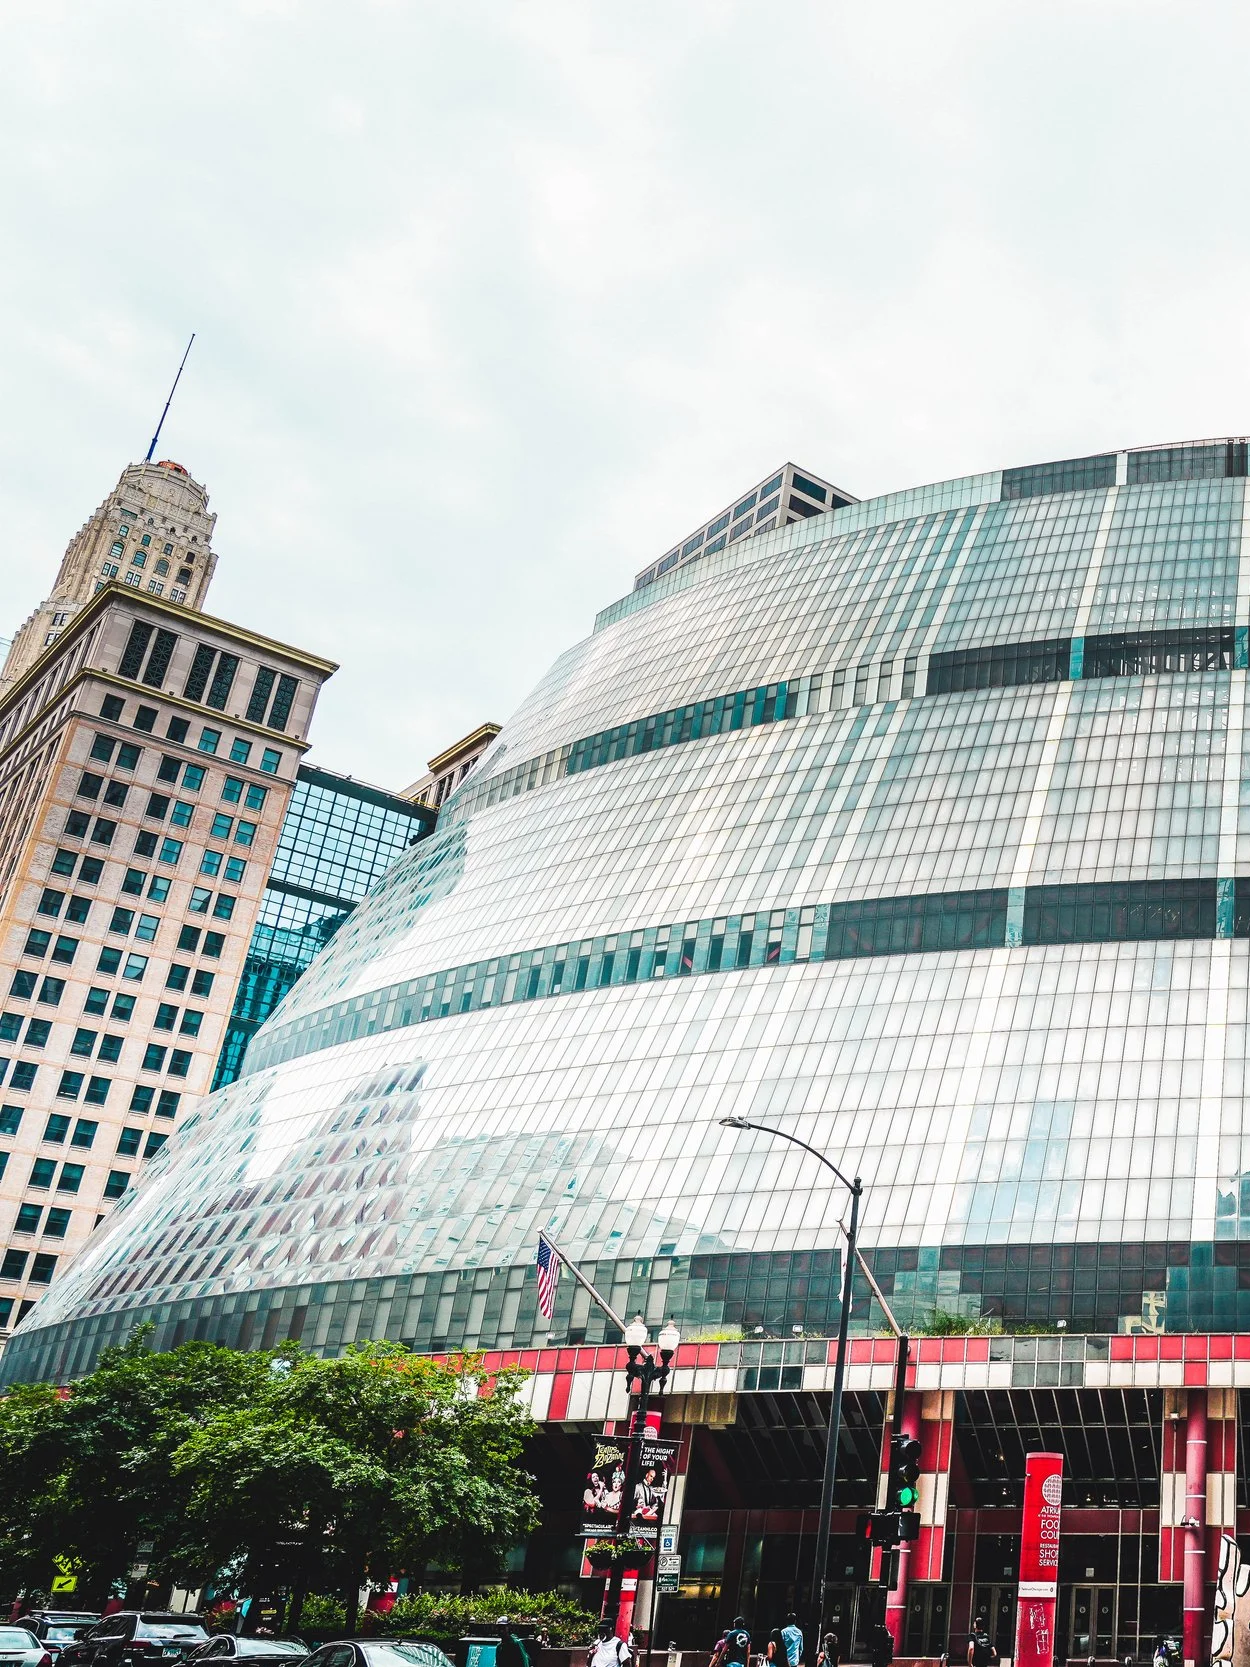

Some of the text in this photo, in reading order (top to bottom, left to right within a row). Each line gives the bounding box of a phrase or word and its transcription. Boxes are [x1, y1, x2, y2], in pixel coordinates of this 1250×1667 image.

[656, 1448, 674, 1456] NIGHT
[1041, 1520, 1060, 1529] FOO
[1040, 1530, 1059, 1539] COU
